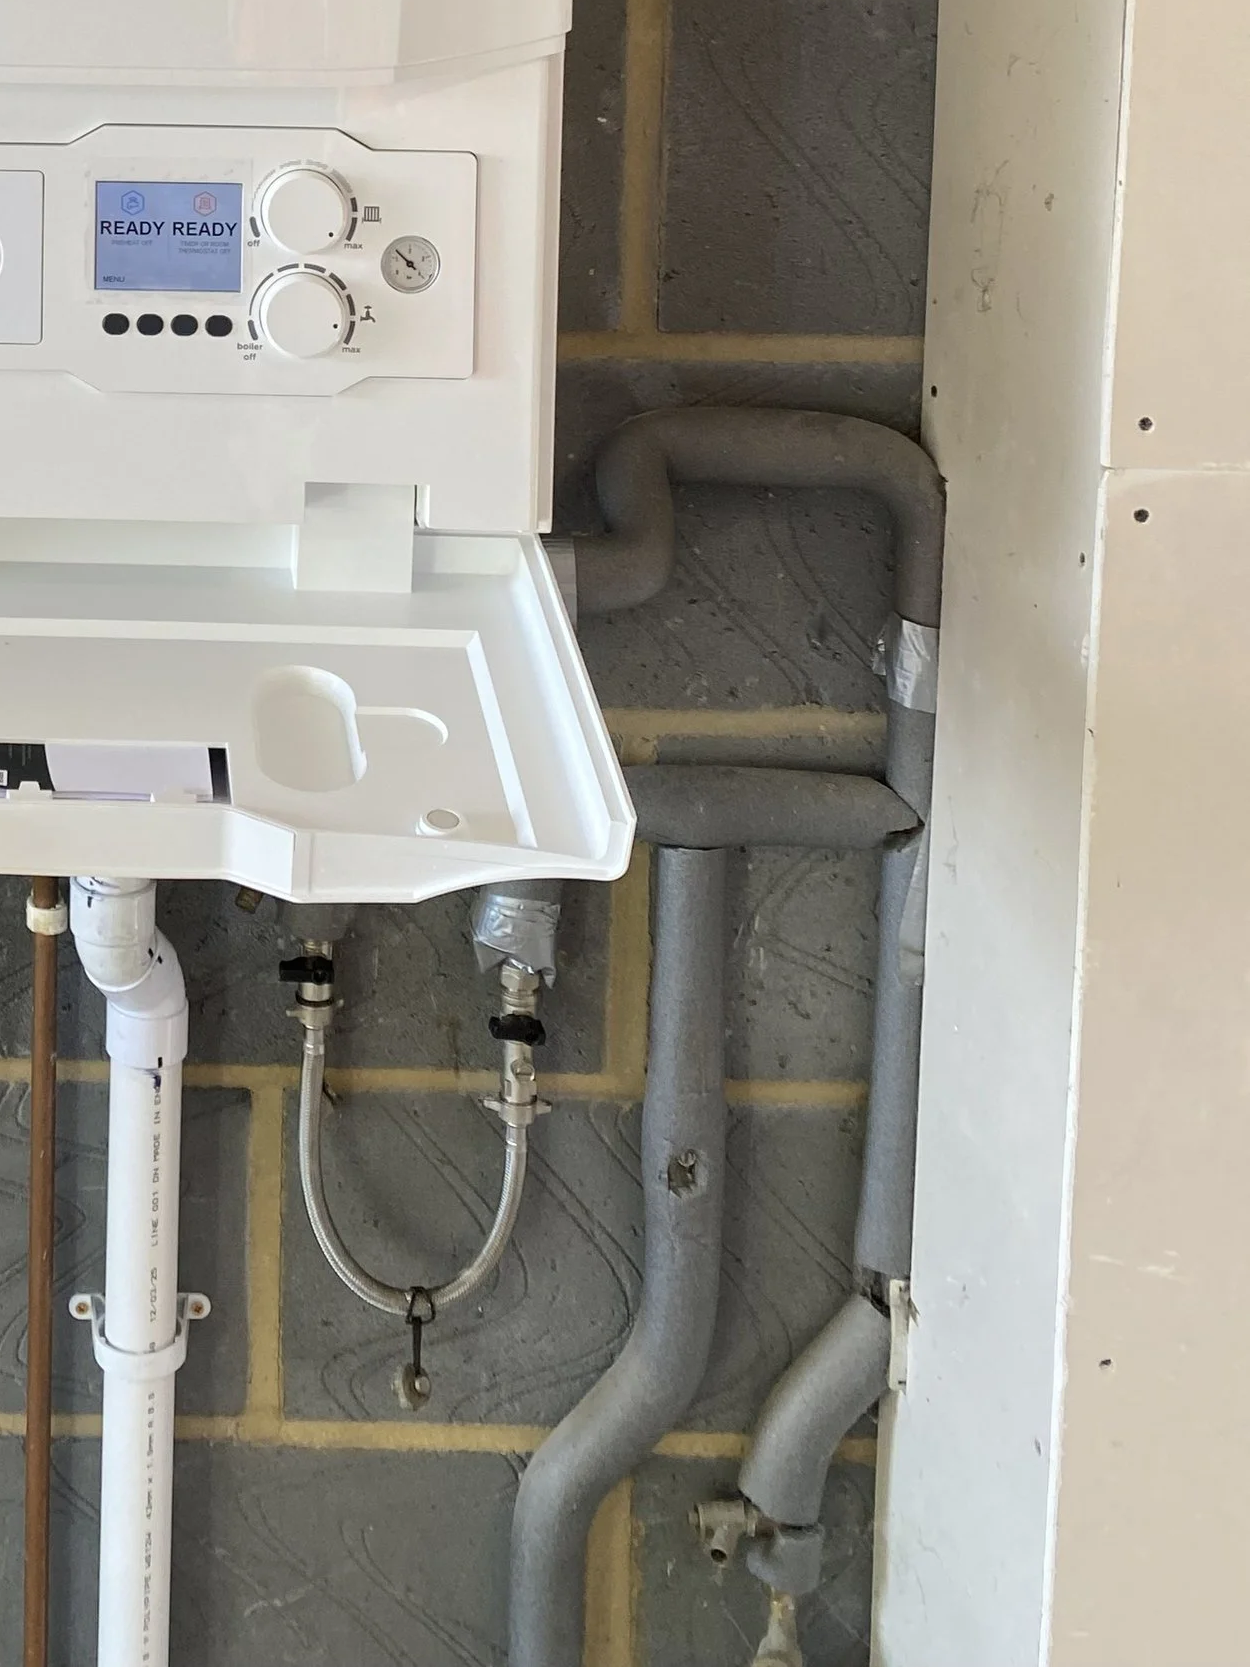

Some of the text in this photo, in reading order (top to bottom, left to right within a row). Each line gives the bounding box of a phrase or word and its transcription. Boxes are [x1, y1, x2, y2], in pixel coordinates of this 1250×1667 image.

[101, 221, 238, 238] READY READY
[247, 239, 261, 247] off
[236, 342, 361, 354] boiler max
[243, 352, 257, 361] off
[154, 1111, 161, 1125] IN
[153, 1134, 161, 1162] MADE
[142, 1574, 152, 1632] POLYPIPE
